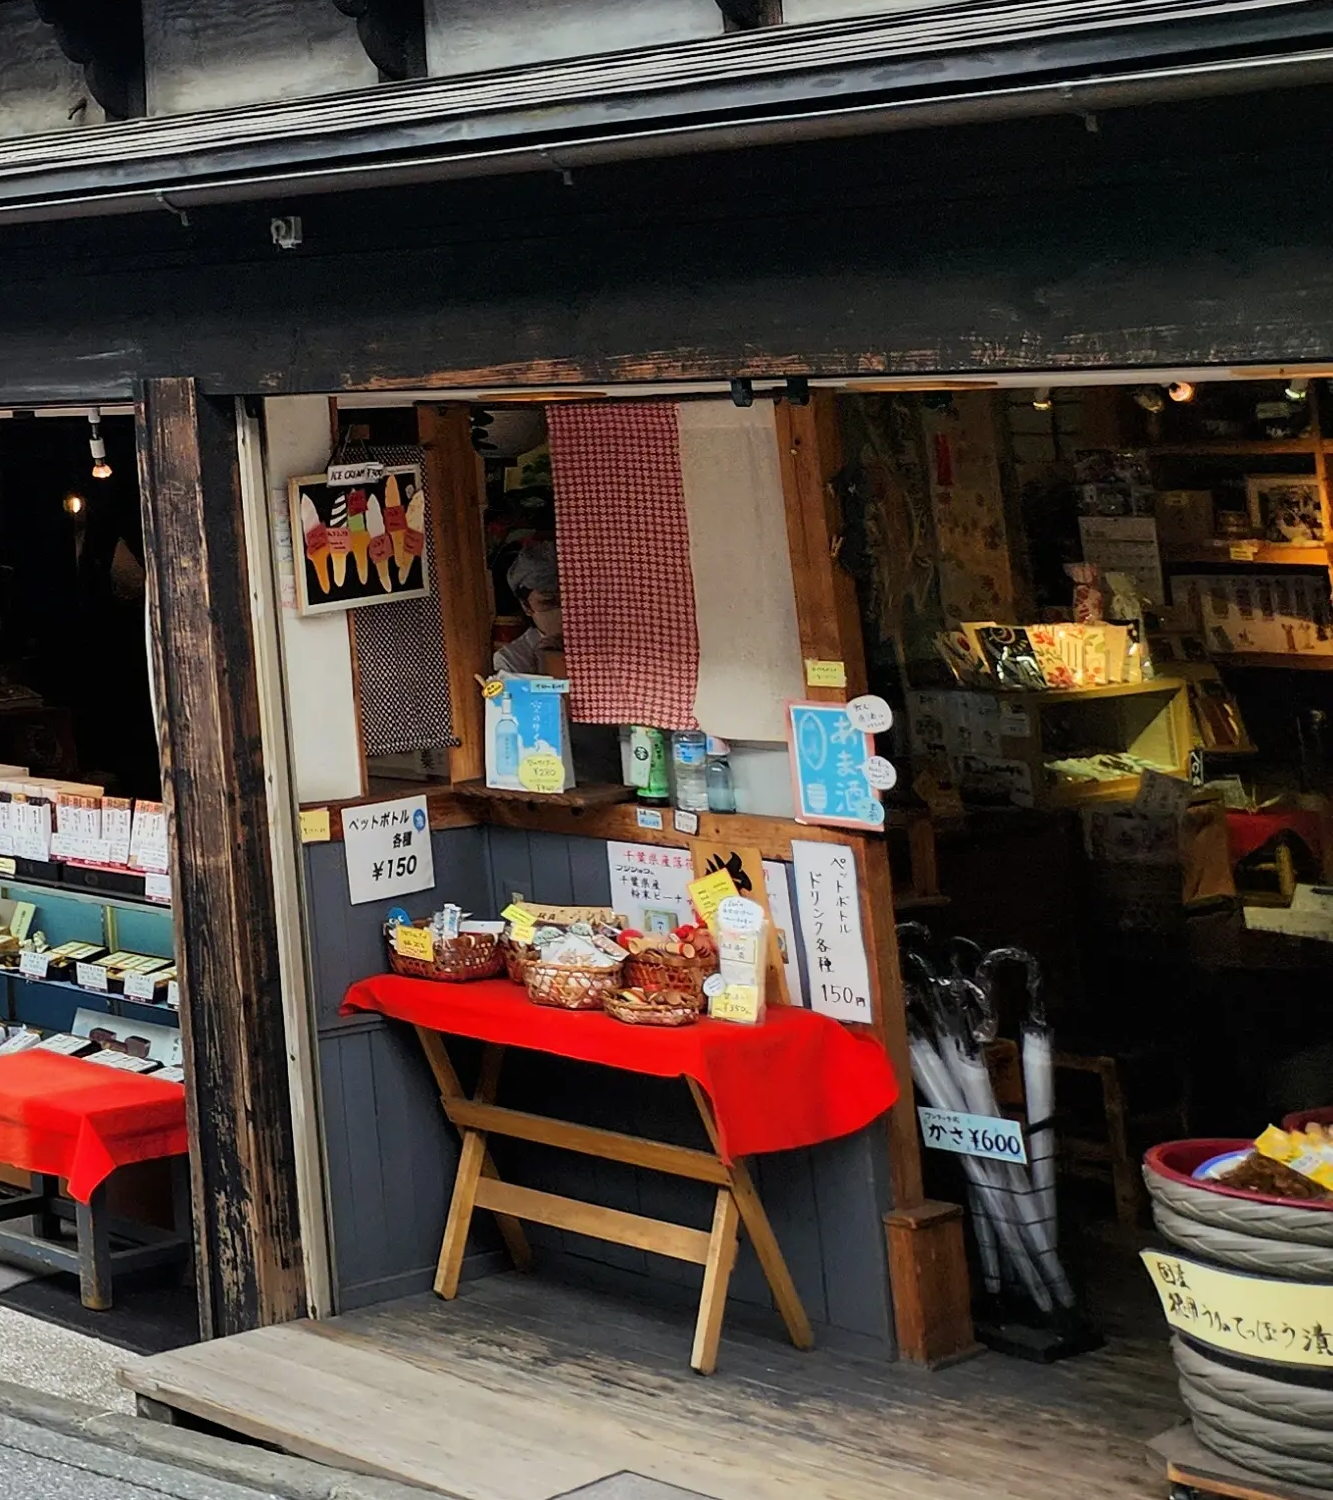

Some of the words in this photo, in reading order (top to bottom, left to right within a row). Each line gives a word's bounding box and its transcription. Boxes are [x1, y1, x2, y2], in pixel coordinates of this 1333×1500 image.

[348, 809, 410, 832] ペットボトル
[392, 831, 413, 849] 各種
[372, 854, 418, 881] ¥150
[619, 875, 661, 891] 千葉県産
[830, 857, 853, 935] ペットボトル
[808, 871, 835, 973] ドリンク各種
[820, 983, 867, 1008] 150円
[928, 1123, 964, 1145] かさ
[968, 1127, 1021, 1155] ¥600
